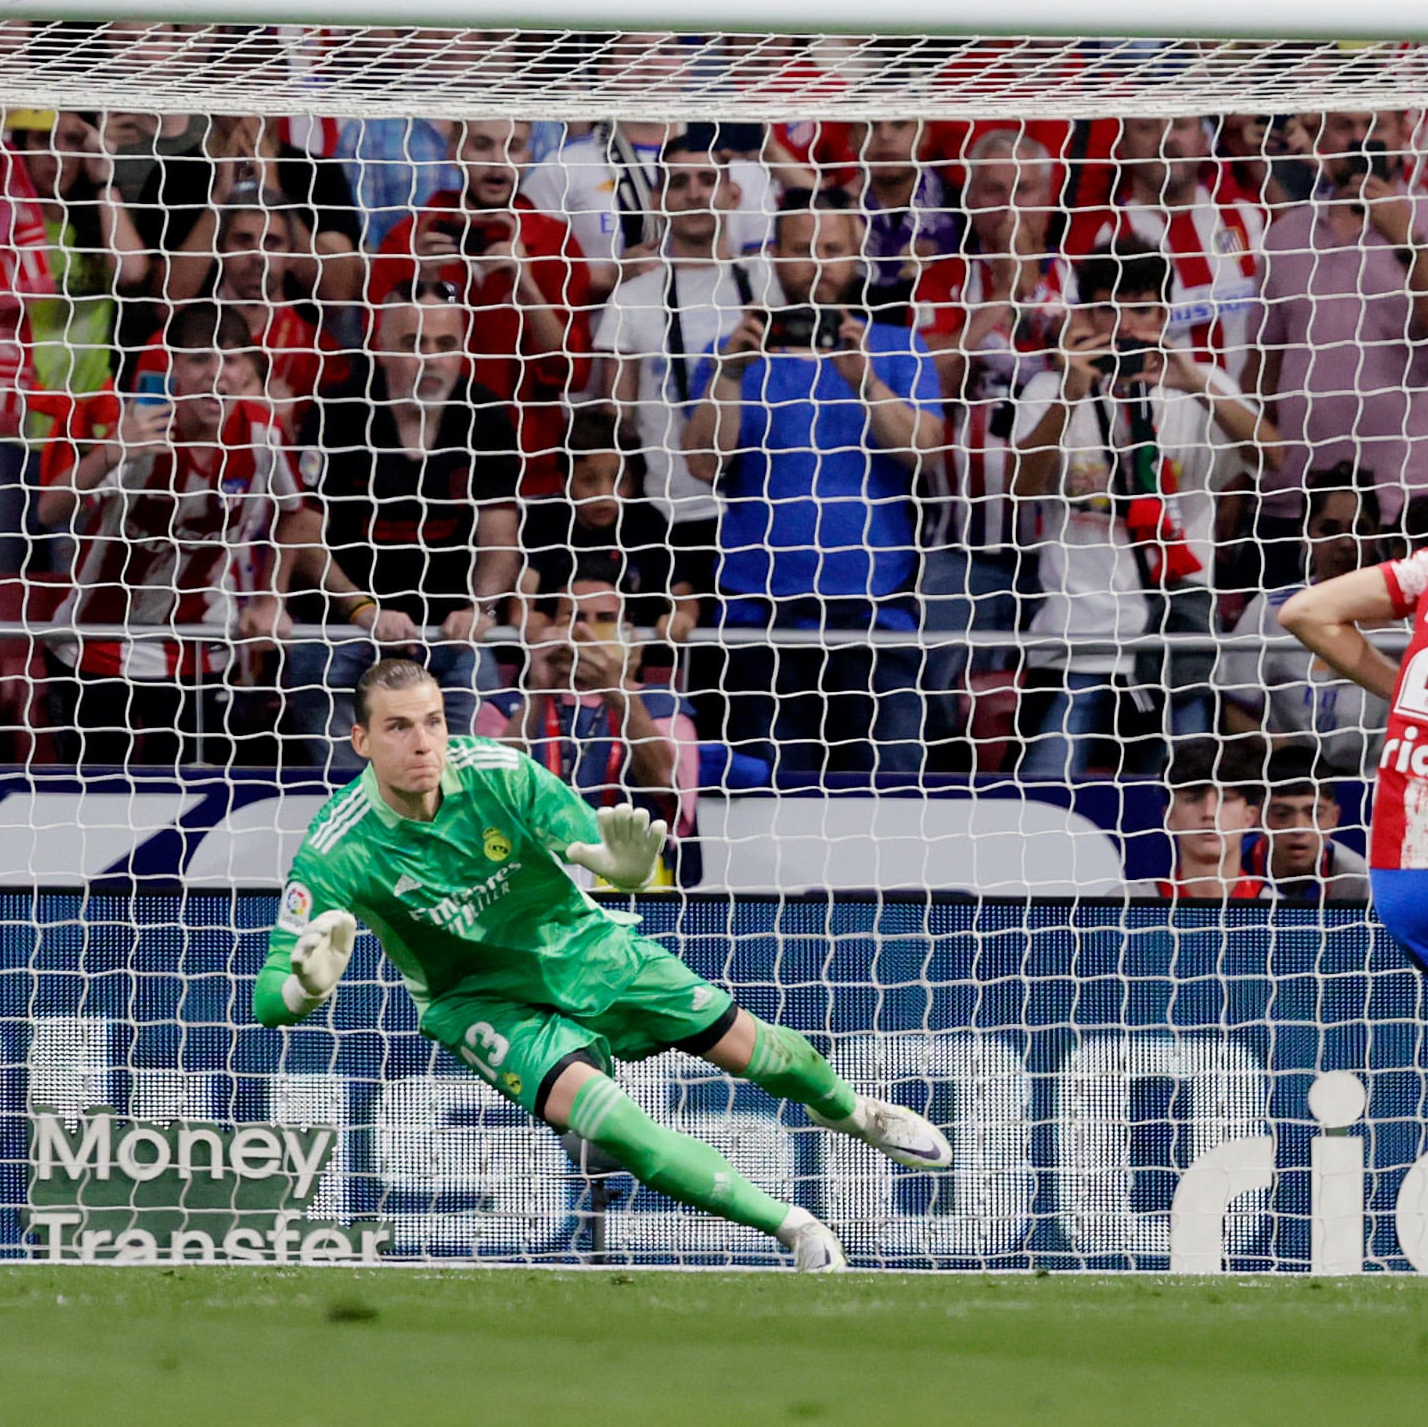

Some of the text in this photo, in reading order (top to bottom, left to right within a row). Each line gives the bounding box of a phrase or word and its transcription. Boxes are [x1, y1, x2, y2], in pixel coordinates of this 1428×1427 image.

[460, 1021, 511, 1081] 13
[37, 1110, 333, 1200] Money
[37, 1210, 393, 1262] Transfer
